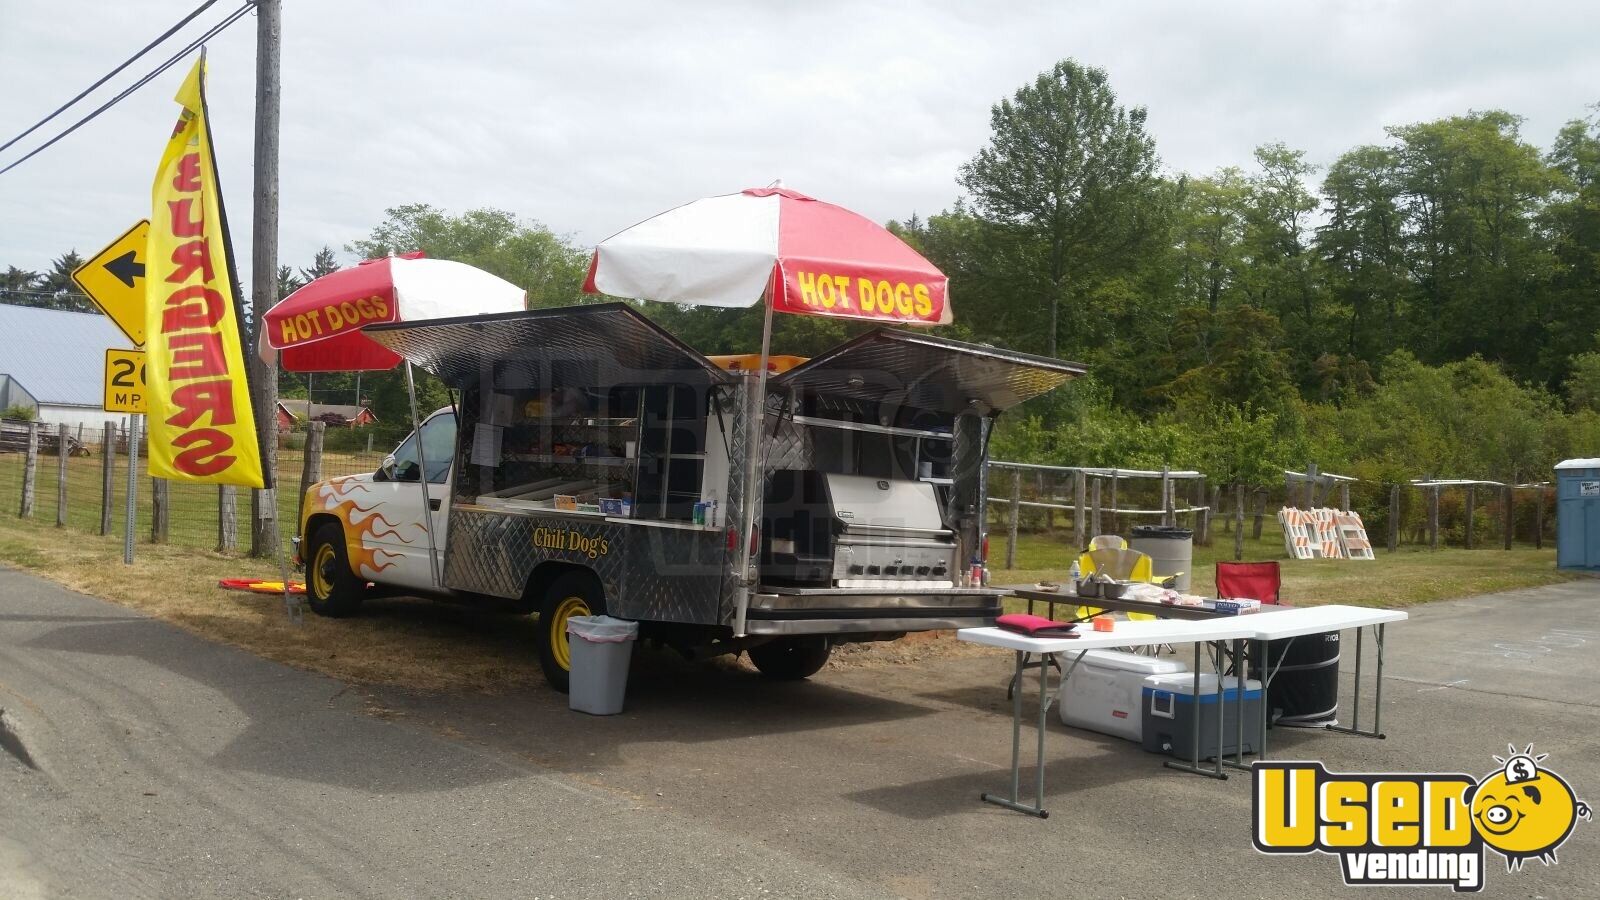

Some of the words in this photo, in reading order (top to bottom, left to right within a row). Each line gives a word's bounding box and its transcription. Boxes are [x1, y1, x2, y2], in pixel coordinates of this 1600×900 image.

[798, 270, 851, 308] HOT
[858, 278, 932, 316] DOGS
[280, 312, 323, 343] HOT
[324, 295, 389, 330] DOGS
[112, 358, 146, 387] 2
[115, 392, 147, 406] MP
[533, 527, 565, 549] Chili
[568, 531, 608, 559] Dog's
